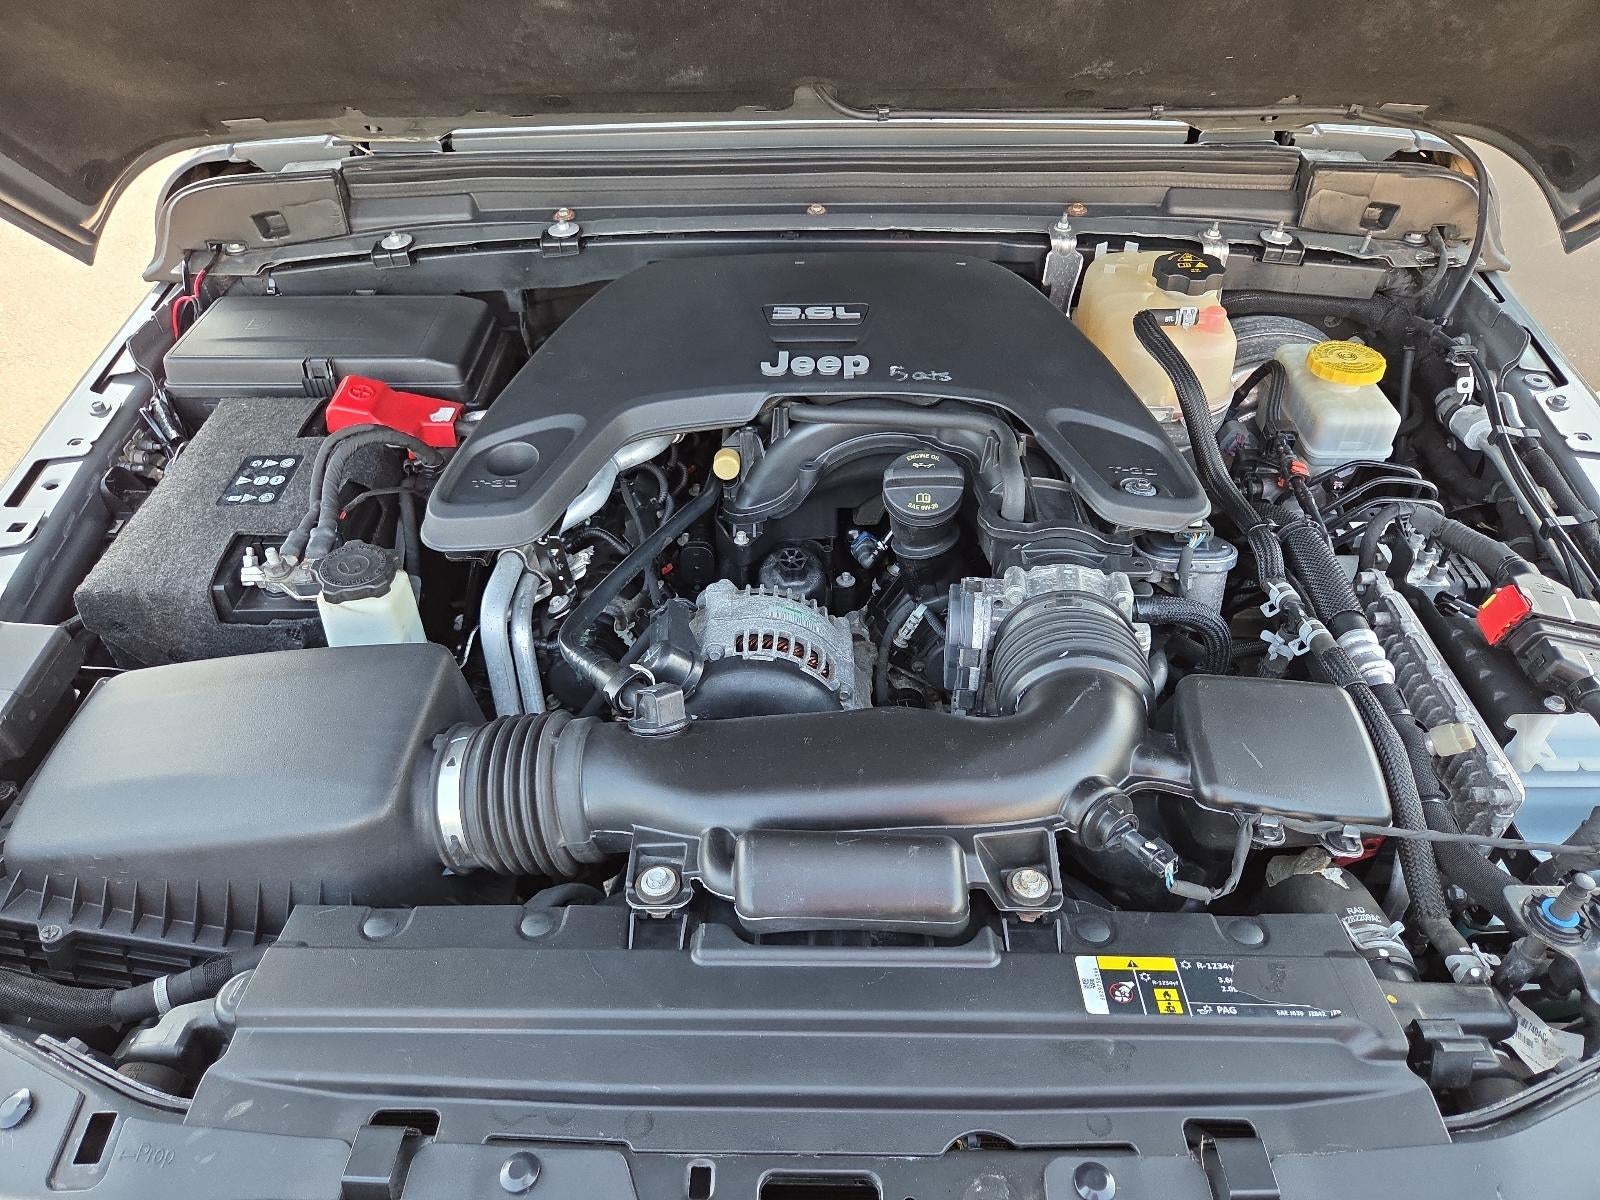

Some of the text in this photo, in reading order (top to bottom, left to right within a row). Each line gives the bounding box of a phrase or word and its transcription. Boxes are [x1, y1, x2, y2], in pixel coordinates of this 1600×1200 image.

[772, 306, 861, 320] 3.6L
[760, 350, 870, 379] Jeep
[906, 453, 940, 462] ENGINE OIL
[907, 502, 920, 511] SAE
[1346, 906, 1366, 915] RAD
[1216, 1006, 1238, 1015] PAG
[135, 1143, 175, 1168] Prop
